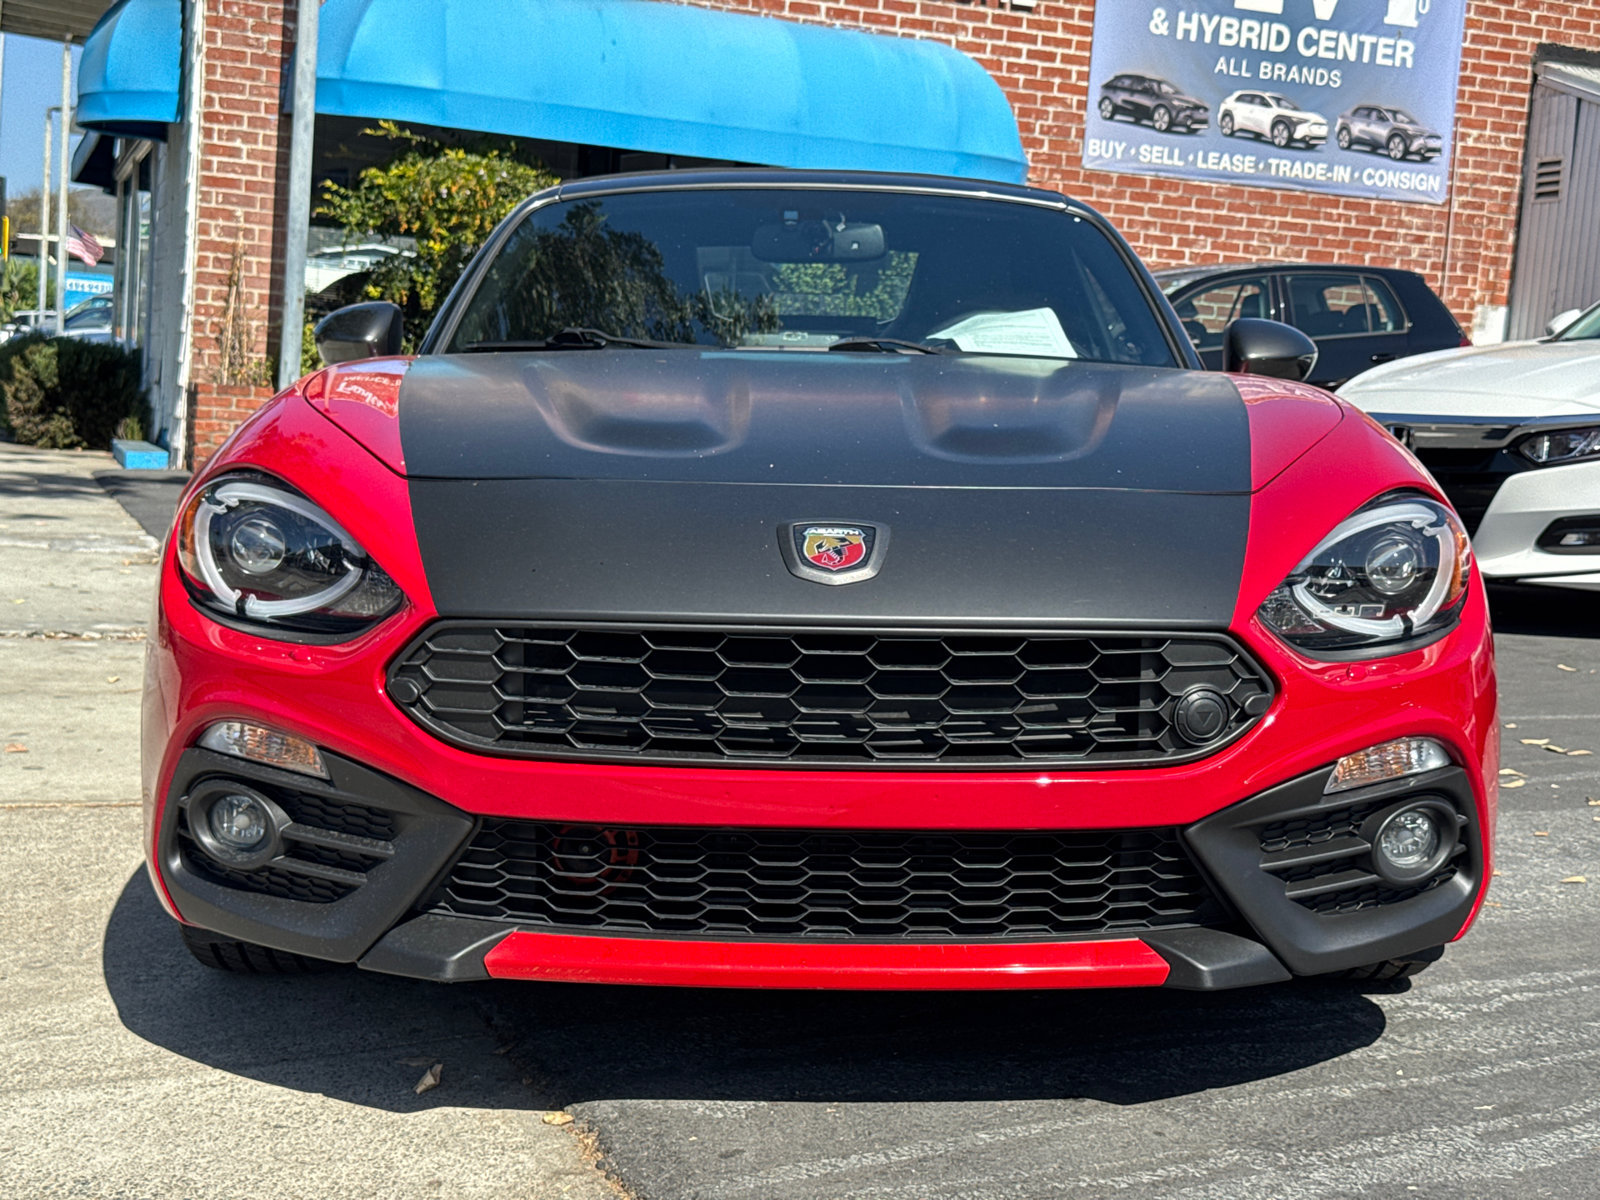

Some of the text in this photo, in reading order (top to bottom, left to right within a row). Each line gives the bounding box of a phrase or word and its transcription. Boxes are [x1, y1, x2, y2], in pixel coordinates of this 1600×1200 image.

[1149, 7, 1169, 36] &
[1176, 10, 1291, 53] HYBRID
[1297, 26, 1416, 69] CENTER
[1214, 55, 1342, 88] ALL BRANDS
[1088, 138, 1441, 193] BUY SELL LEASE TRADE-IN CONSIGN
